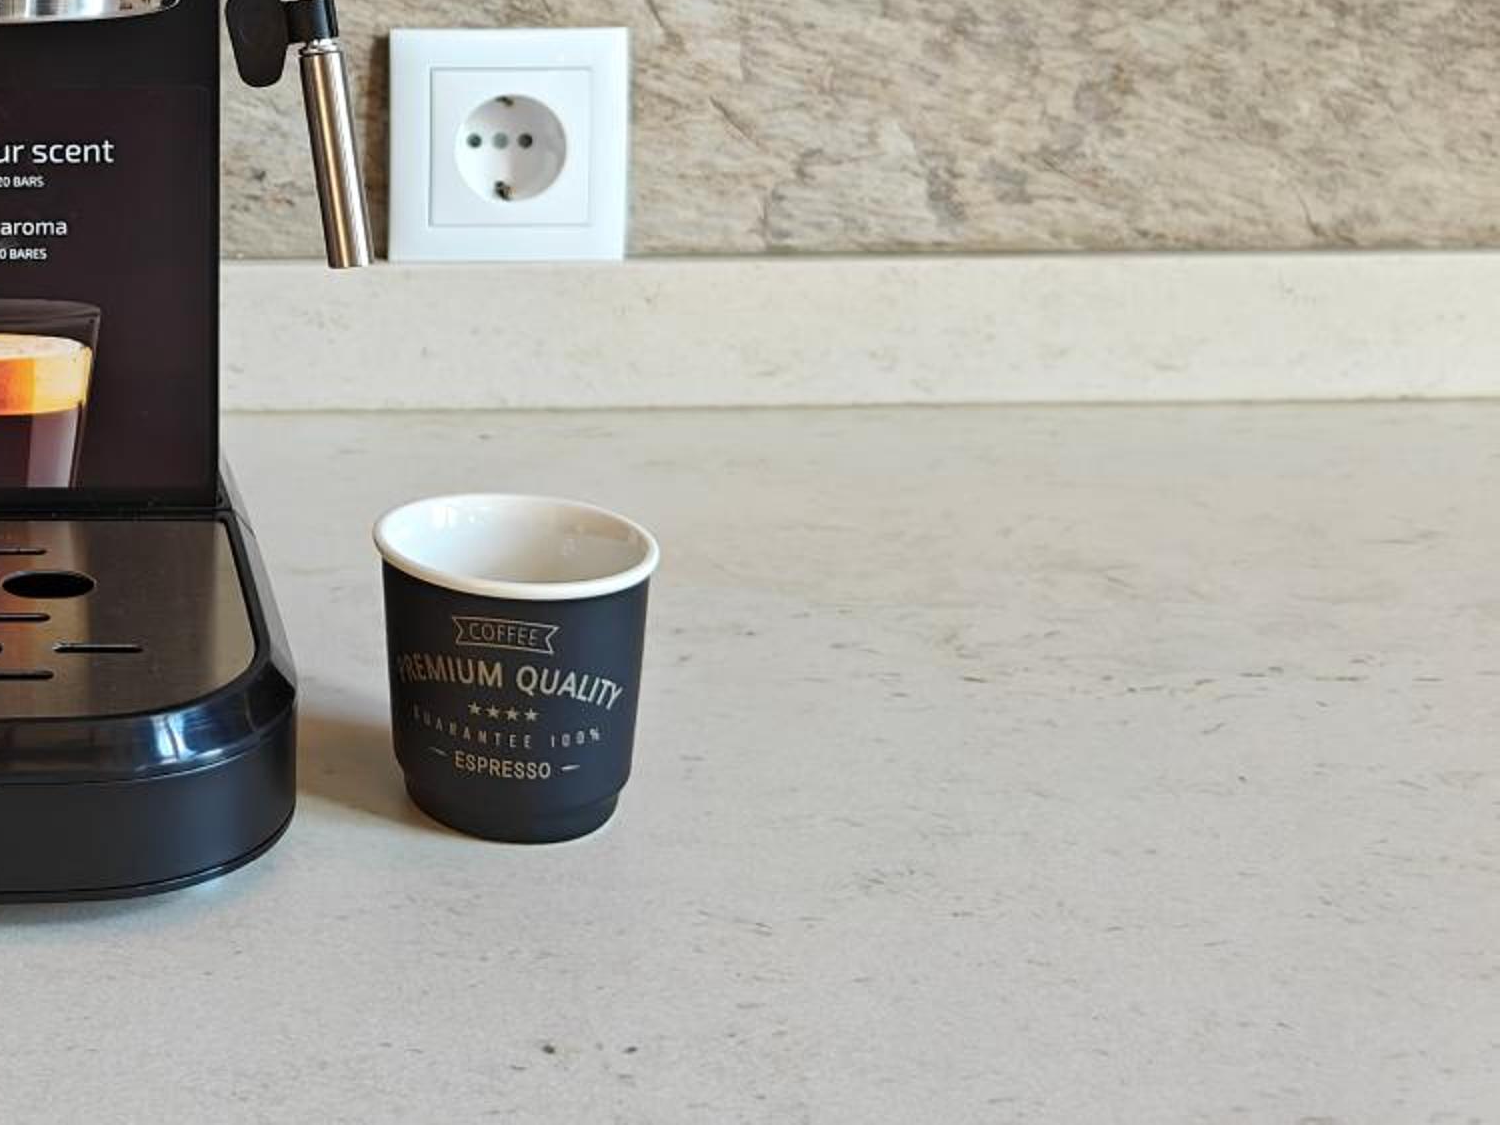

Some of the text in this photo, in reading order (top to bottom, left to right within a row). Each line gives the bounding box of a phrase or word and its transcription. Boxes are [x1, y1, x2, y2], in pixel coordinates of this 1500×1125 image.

[32, 140, 115, 164] scent
[13, 176, 45, 188] BARS
[0, 222, 68, 236] aroma
[9, 248, 47, 260] BARES
[468, 624, 539, 647] COFFEE
[515, 666, 623, 709] QUALITY
[550, 727, 600, 748] 100%
[454, 750, 551, 780] ESPRESSO
